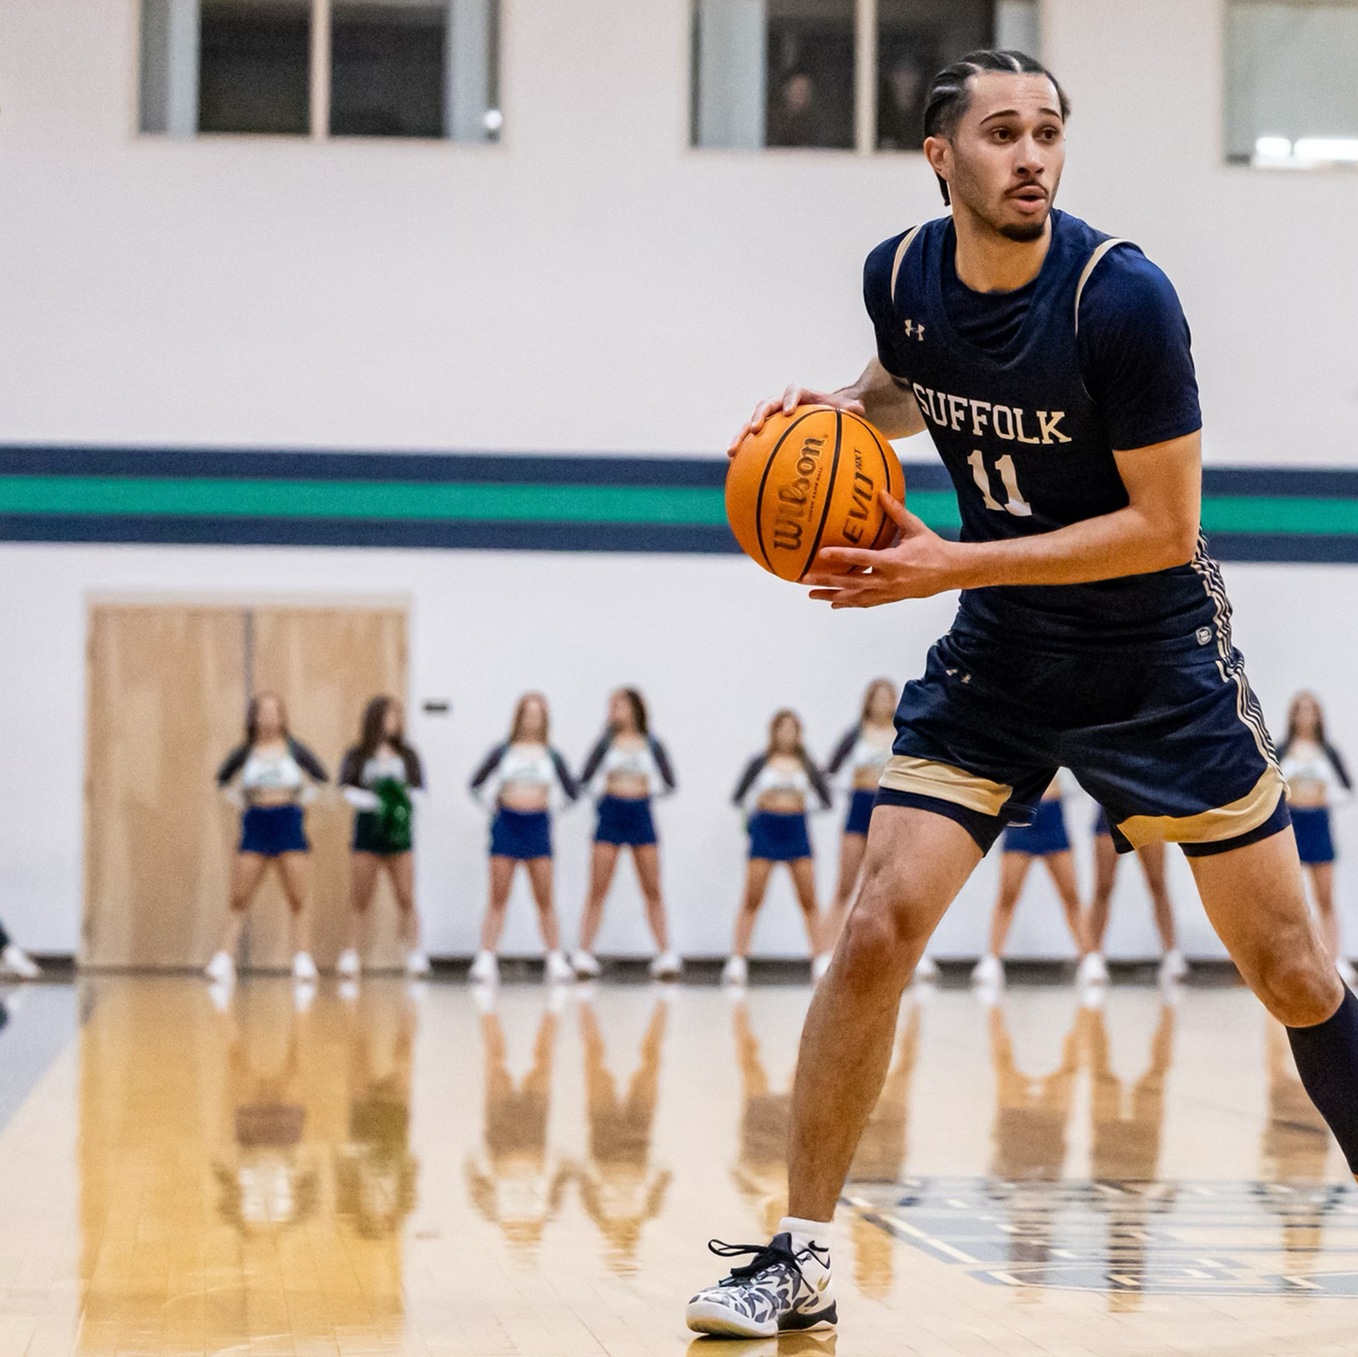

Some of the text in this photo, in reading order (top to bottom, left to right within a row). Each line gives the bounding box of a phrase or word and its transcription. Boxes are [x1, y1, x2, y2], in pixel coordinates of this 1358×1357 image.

[912, 382, 1072, 445] SUFFOLK
[773, 438, 826, 550] Wilson
[842, 471, 874, 545] EVO
[967, 449, 1032, 517] 11
